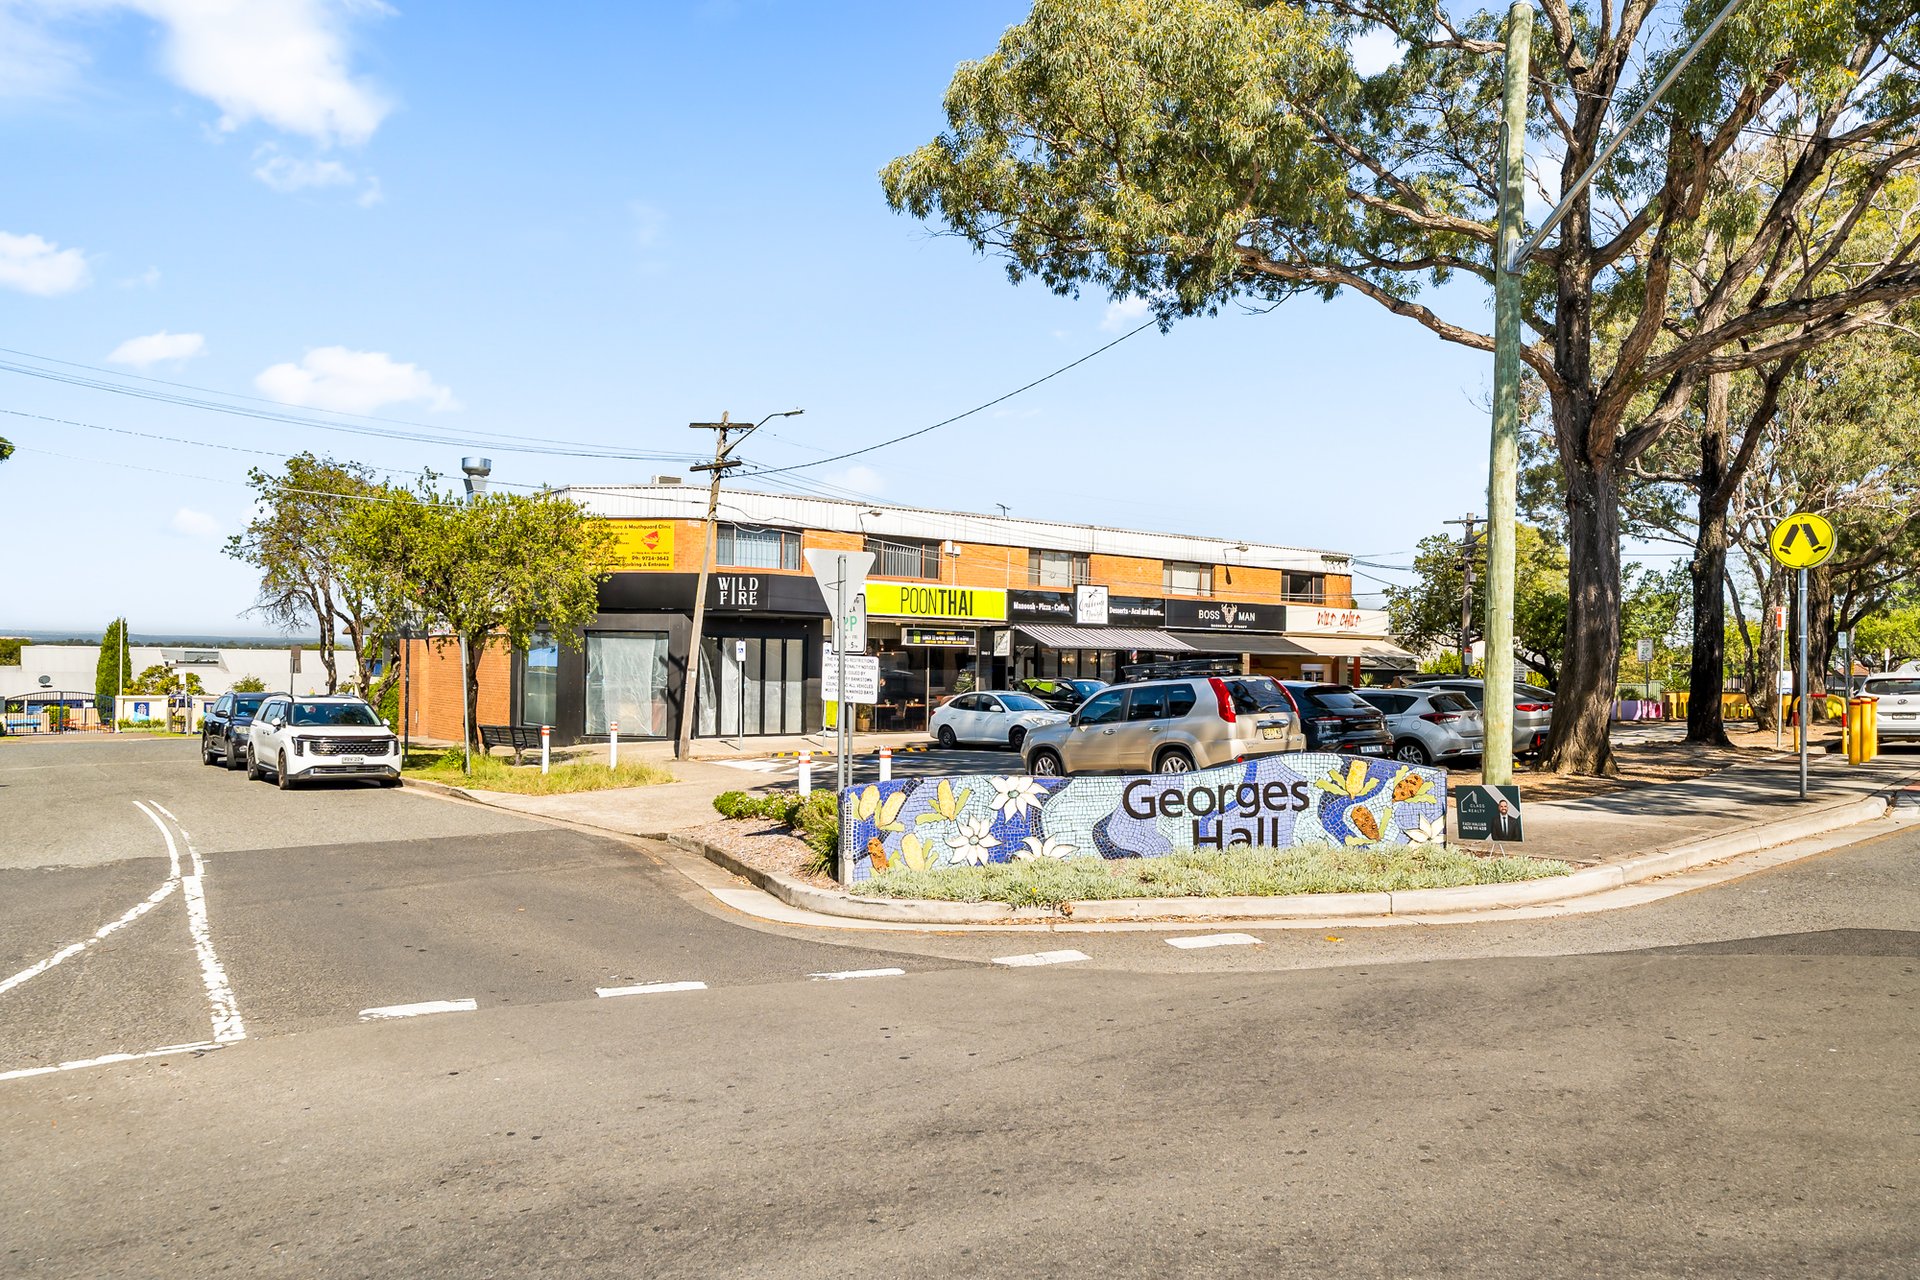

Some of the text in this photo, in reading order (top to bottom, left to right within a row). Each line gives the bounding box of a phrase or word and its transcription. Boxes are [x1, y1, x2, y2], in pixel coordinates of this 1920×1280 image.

[718, 577, 758, 591] WILD
[720, 591, 758, 605] FIRE
[1054, 603, 1070, 612] Coffee
[1198, 609, 1255, 622] BOSS MAN
[1122, 779, 1310, 819] Georges
[1192, 816, 1278, 850] Hall
